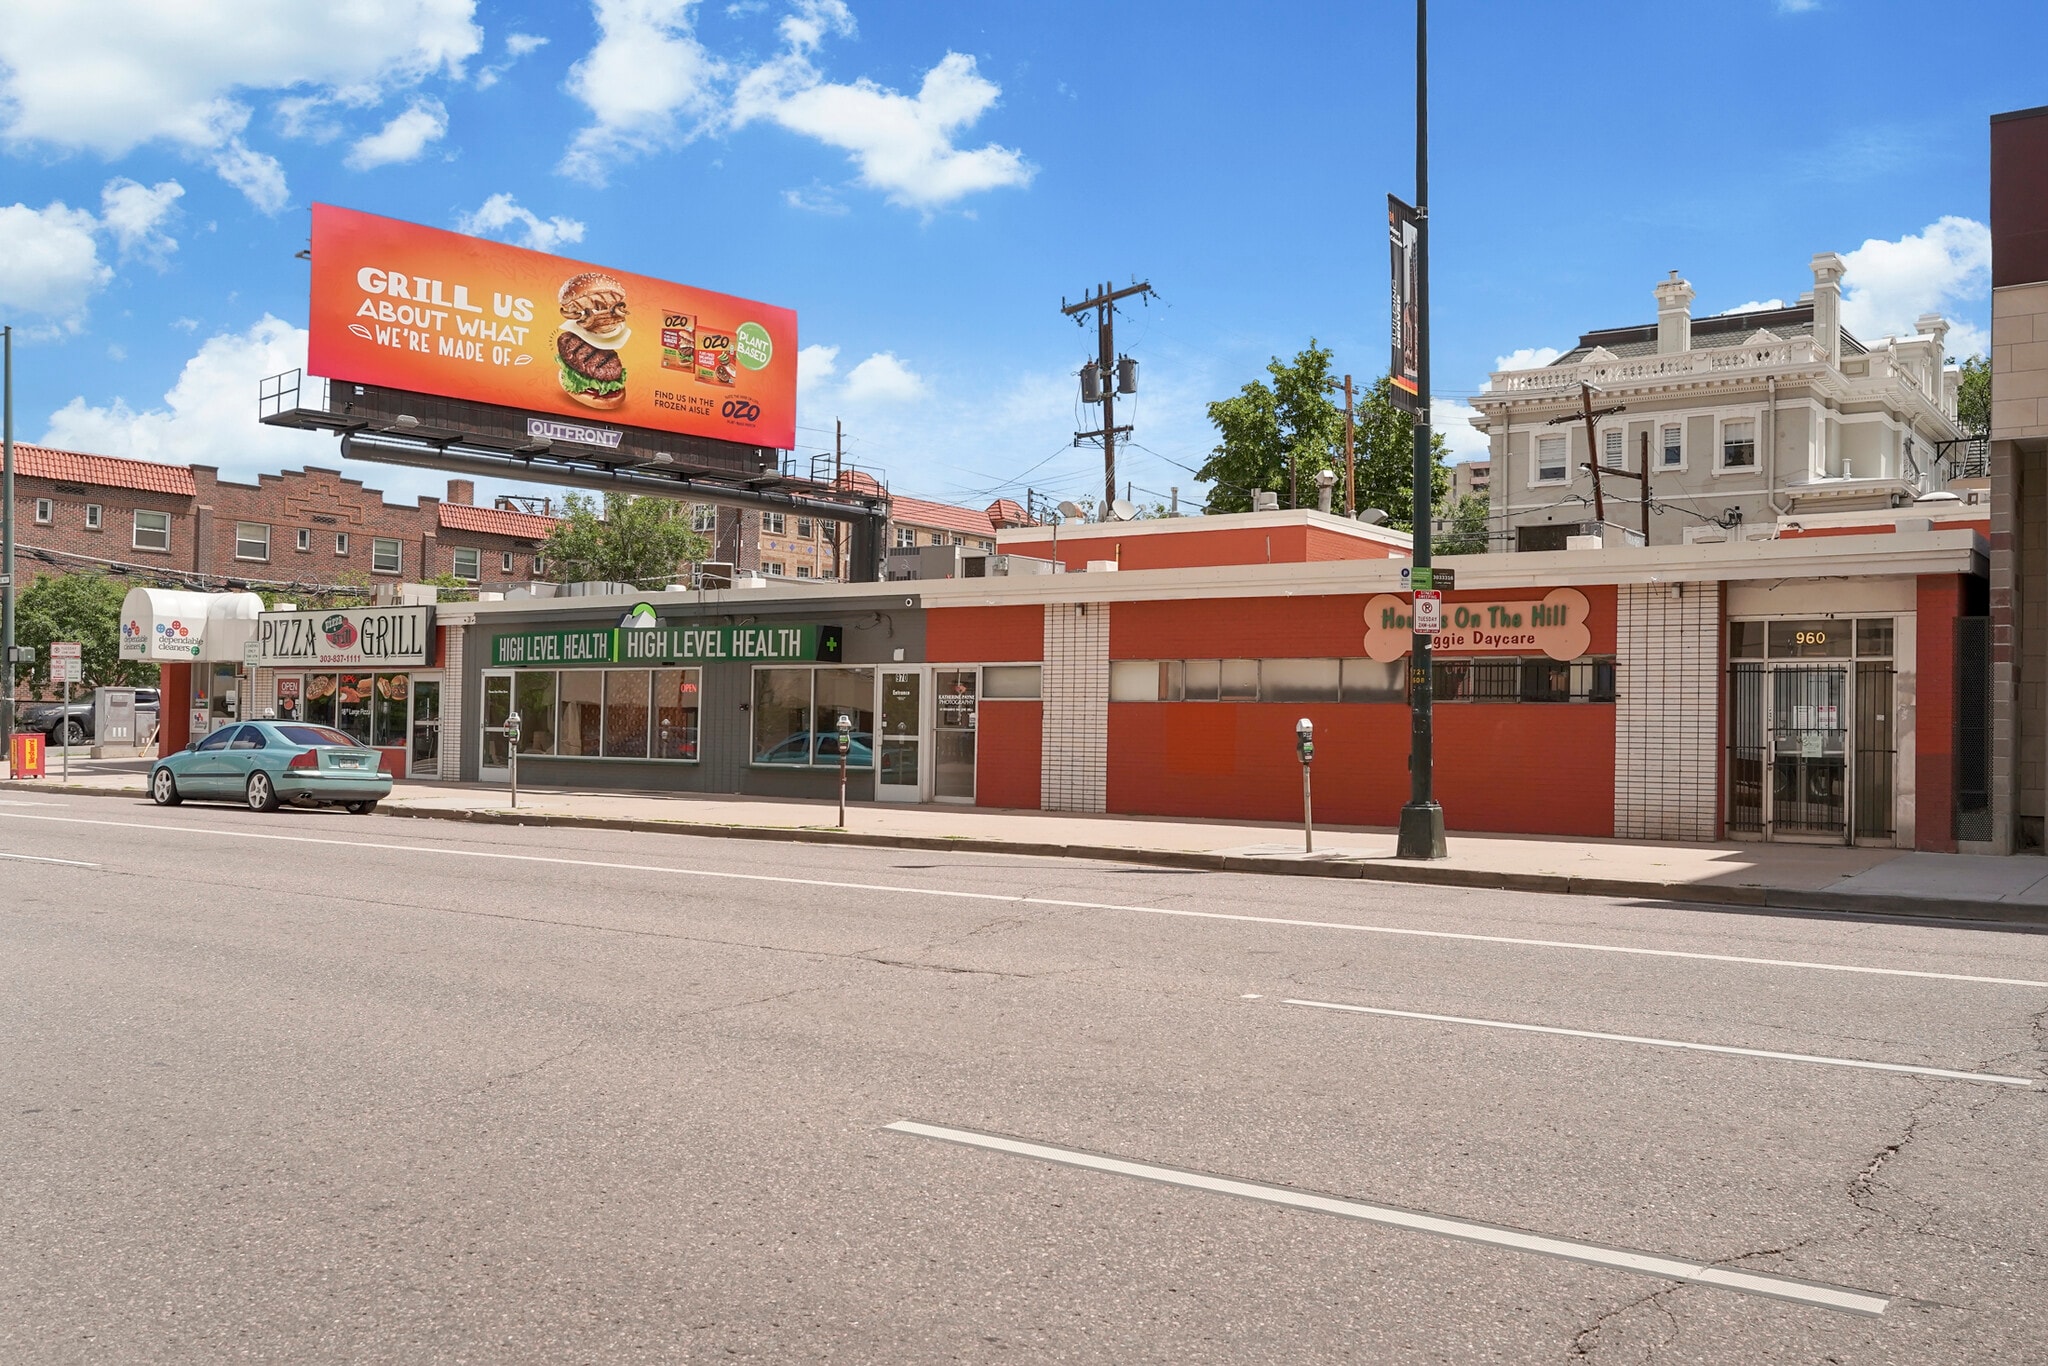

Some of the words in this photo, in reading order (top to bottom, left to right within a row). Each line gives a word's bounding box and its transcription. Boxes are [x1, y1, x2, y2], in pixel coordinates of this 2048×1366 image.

[357, 267, 483, 314] GRILL
[493, 292, 534, 322] US
[356, 298, 448, 331] ABOUT
[456, 315, 529, 346] WHAT
[664, 315, 688, 327] OZO
[375, 324, 430, 353] WE'RE
[438, 336, 484, 362] MADE
[492, 346, 512, 366] OF
[703, 335, 729, 349] OZO
[739, 330, 768, 351] PLANT
[737, 342, 767, 363] BASED
[654, 390, 674, 400] FIND
[676, 393, 687, 402] US
[688, 396, 697, 404] IN
[699, 398, 714, 408] THE
[654, 400, 687, 411] FROZEN
[688, 407, 710, 416] AISLE
[722, 401, 760, 422] OZO
[531, 421, 617, 445] OUTFRONT
[1382, 607, 1448, 629] Hous
[1454, 606, 1481, 629] On
[1487, 605, 1522, 628] The
[1531, 604, 1566, 627] Hill
[124, 635, 148, 643] dependable
[158, 635, 204, 646] dependable
[262, 619, 317, 657] PIZZA
[361, 615, 423, 658] GRILL
[627, 631, 667, 657] HIGH
[673, 630, 726, 657] LEVEL
[732, 629, 801, 657] HEALTH
[1432, 633, 1464, 648] ggie
[1473, 631, 1535, 648] Daycare
[1796, 632, 1825, 644] 960
[158, 644, 190, 652] cleaners
[499, 637, 524, 661] HIGH
[527, 635, 560, 660] LEVEL
[564, 633, 607, 659] HEALTH
[320, 654, 361, 663] 303-837-1111
[896, 673, 908, 682] 970
[281, 682, 298, 691] OPEN
[680, 683, 697, 692] OPEN
